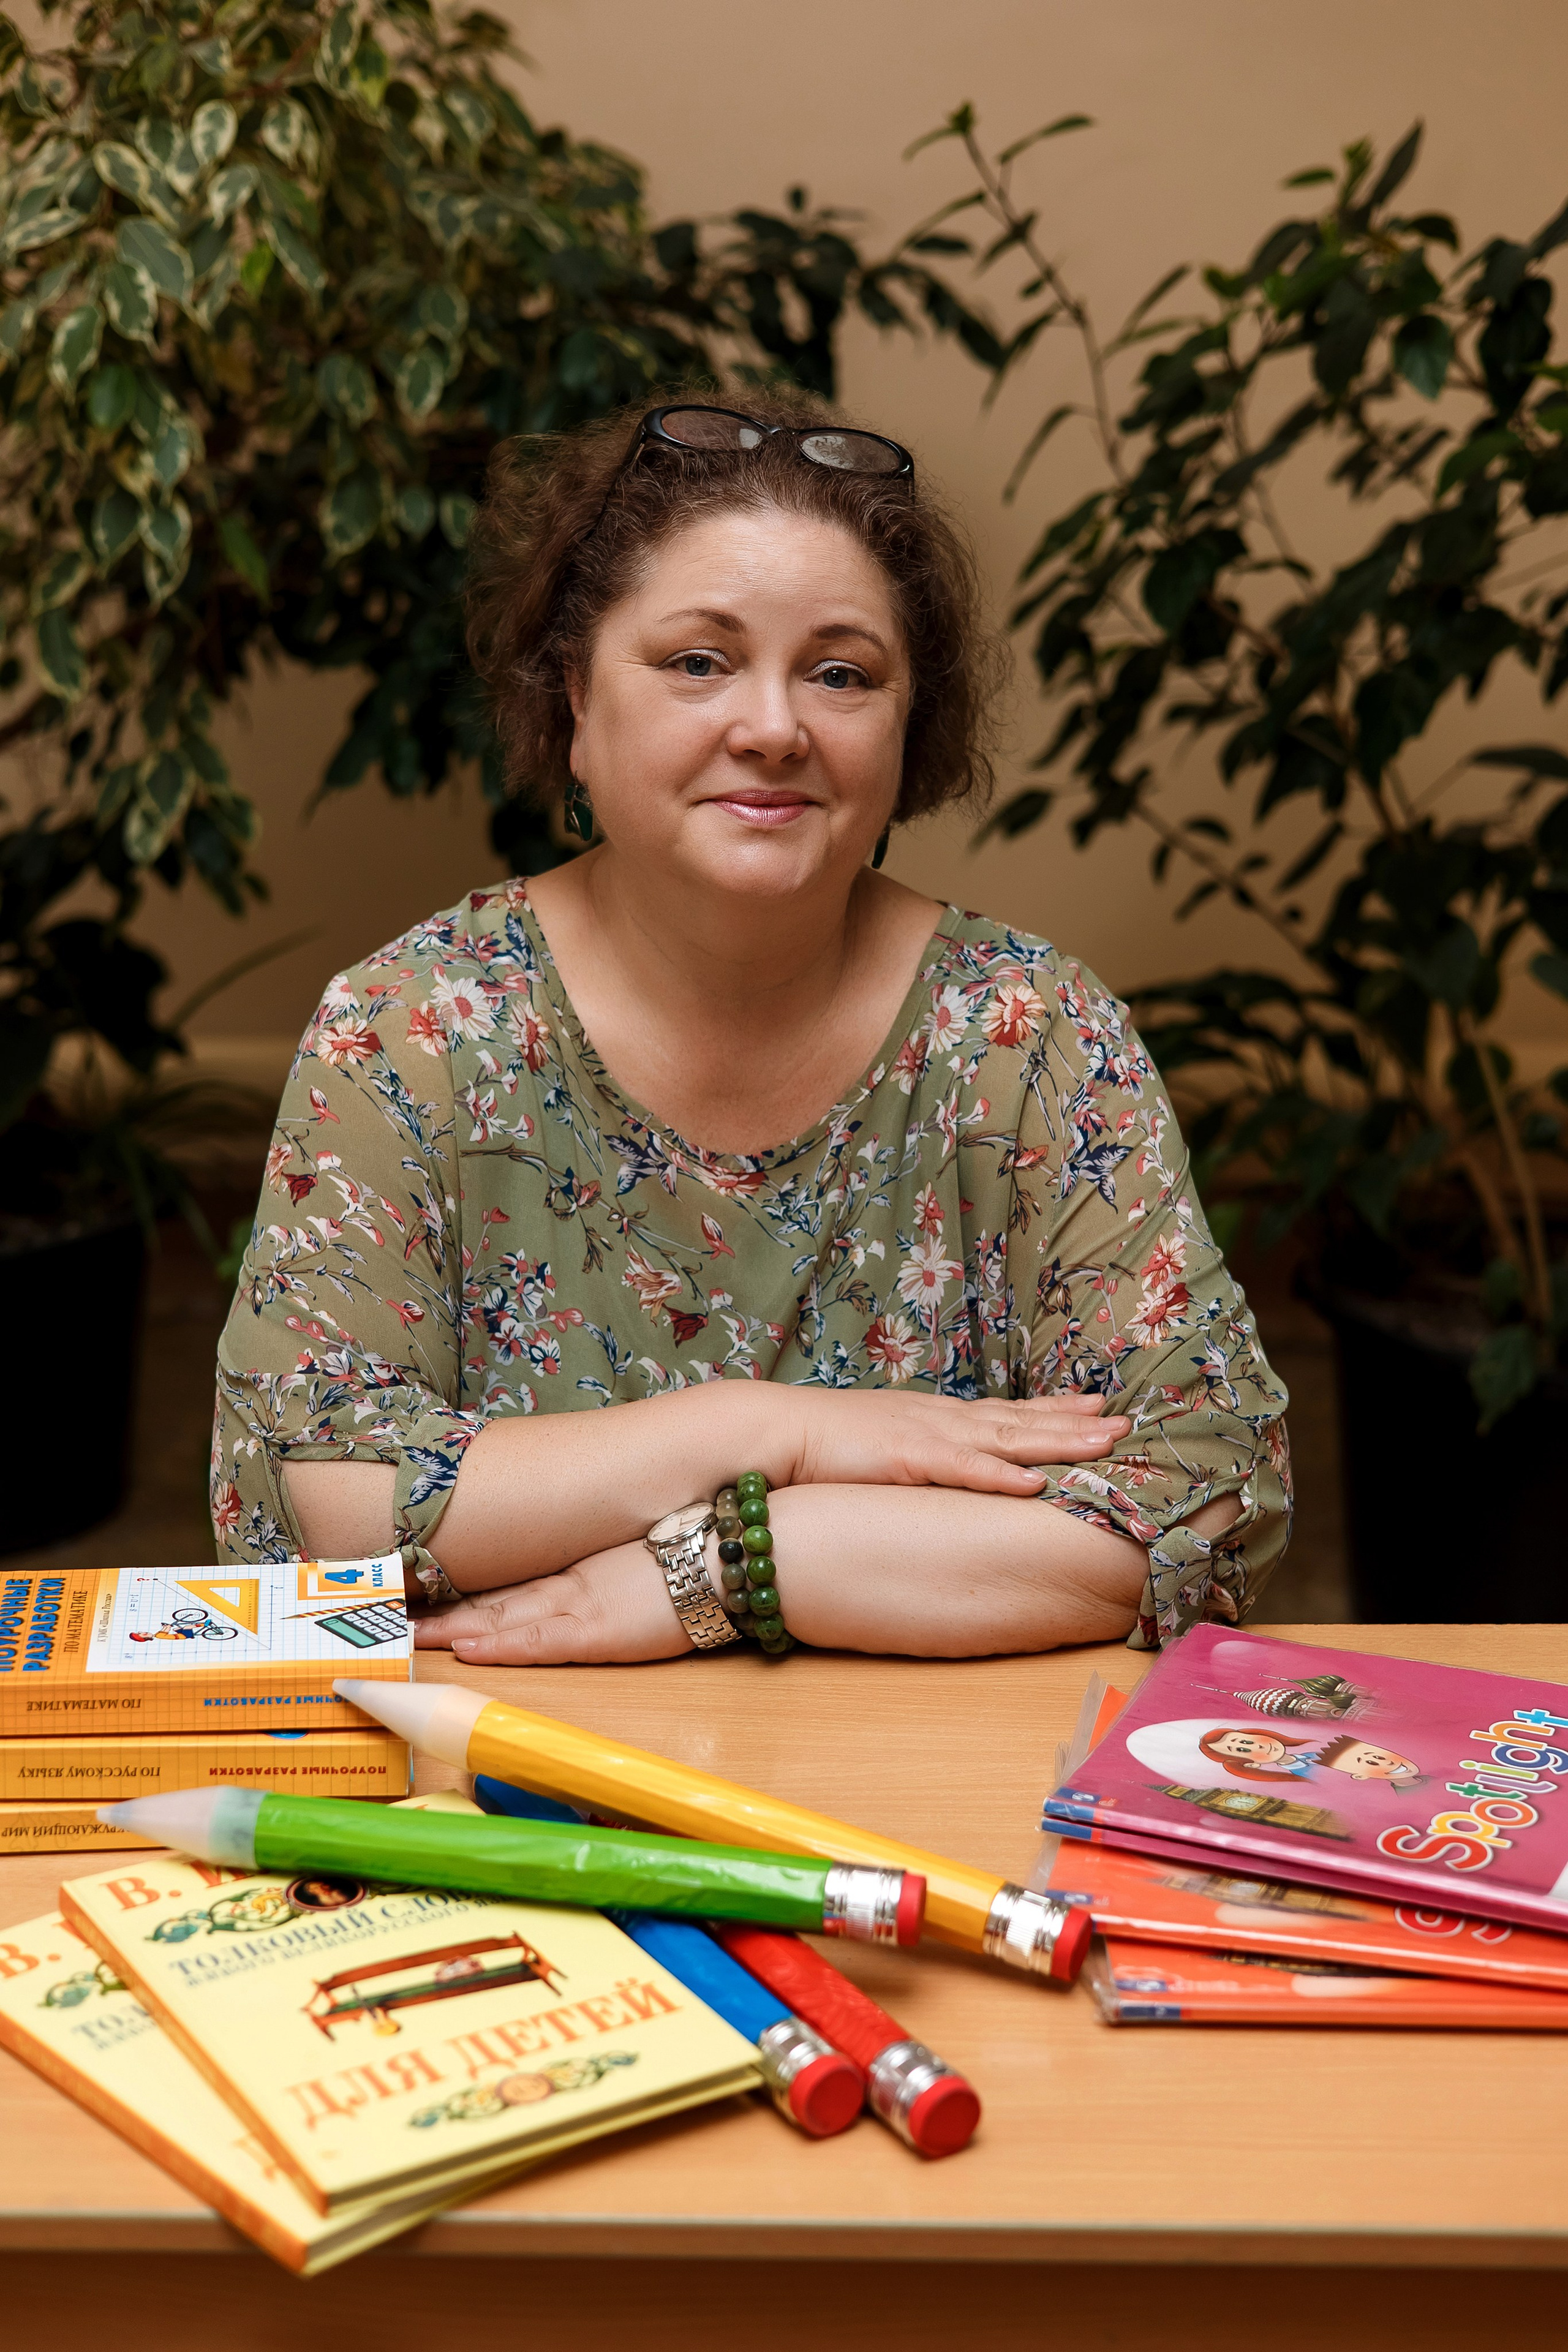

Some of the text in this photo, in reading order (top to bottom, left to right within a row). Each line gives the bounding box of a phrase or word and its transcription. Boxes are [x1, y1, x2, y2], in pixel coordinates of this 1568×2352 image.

[325, 1569, 364, 1584] 4
[371, 1563, 383, 1587] КЛАСС
[22, 1578, 66, 1672] РАЗРАБОТКИ
[64, 1591, 88, 1653] ПО МАТЕМАТИКЕ
[98, 1628, 108, 1638] УМК
[27, 1698, 141, 1711] ПО МАТЕМАТИКЕ
[204, 1695, 349, 1706] ОЧНЫЕ РАЗРАБОТКИ
[18, 1765, 160, 1777] ПО РУССКОМУ ЯЗЫКУ
[209, 1766, 386, 1776] ПОУРОЧНЫЕ РАЗРАБОТКИ
[1377, 1708, 1568, 1871] Spotlight
[1, 1823, 127, 1838] РУЖАЮЩИЙ МИР
[170, 1906, 374, 1976] ТОЛКОВЫЙ
[285, 1977, 683, 2133] ДЛЯ ДЕТЕЙ
